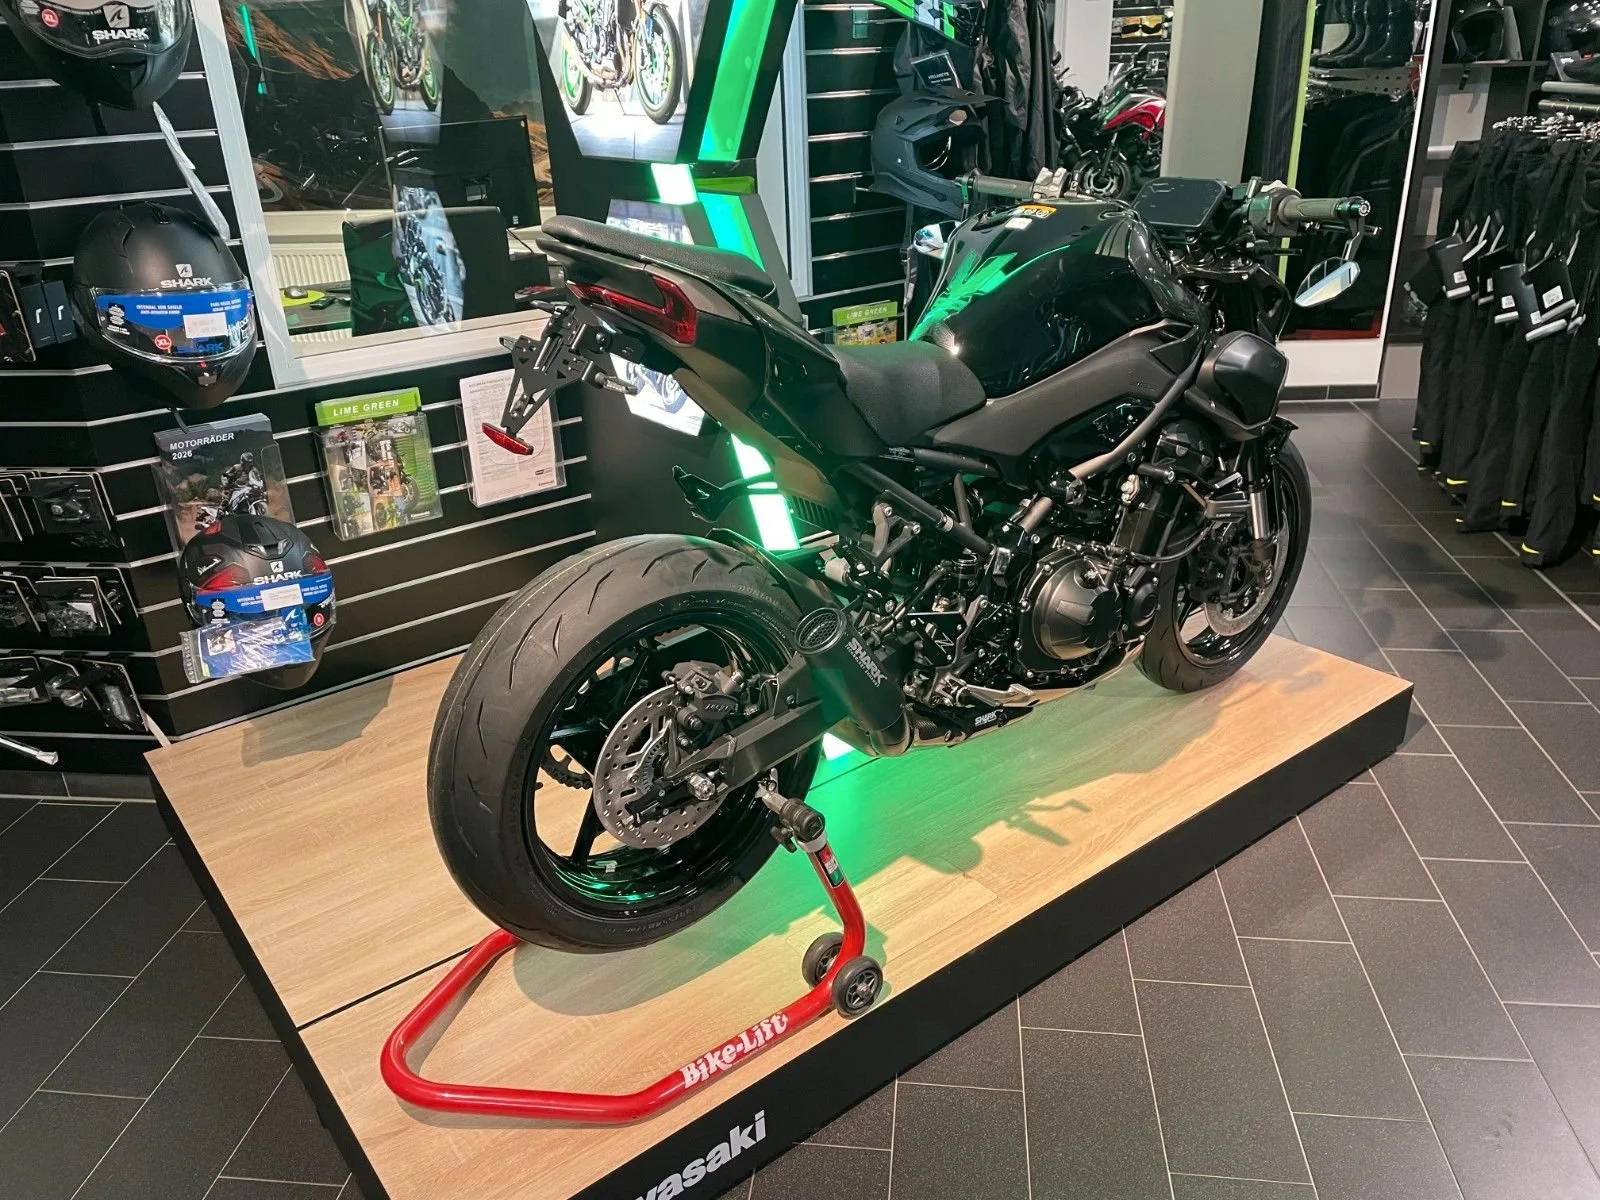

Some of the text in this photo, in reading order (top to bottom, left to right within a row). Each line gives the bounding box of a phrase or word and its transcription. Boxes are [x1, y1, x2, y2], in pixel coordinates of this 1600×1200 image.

[92, 28, 149, 41] SHARK
[161, 277, 214, 288] SHARK
[847, 306, 888, 319] LIME GREEN
[155, 338, 169, 346] XL
[333, 399, 400, 417] LIME GREEN
[169, 432, 235, 451] MOTORRÄDER
[172, 449, 193, 460] 2026
[253, 570, 303, 585] SHARK
[849, 637, 888, 685] SHARK
[680, 1011, 790, 1089] Bike-Lift
